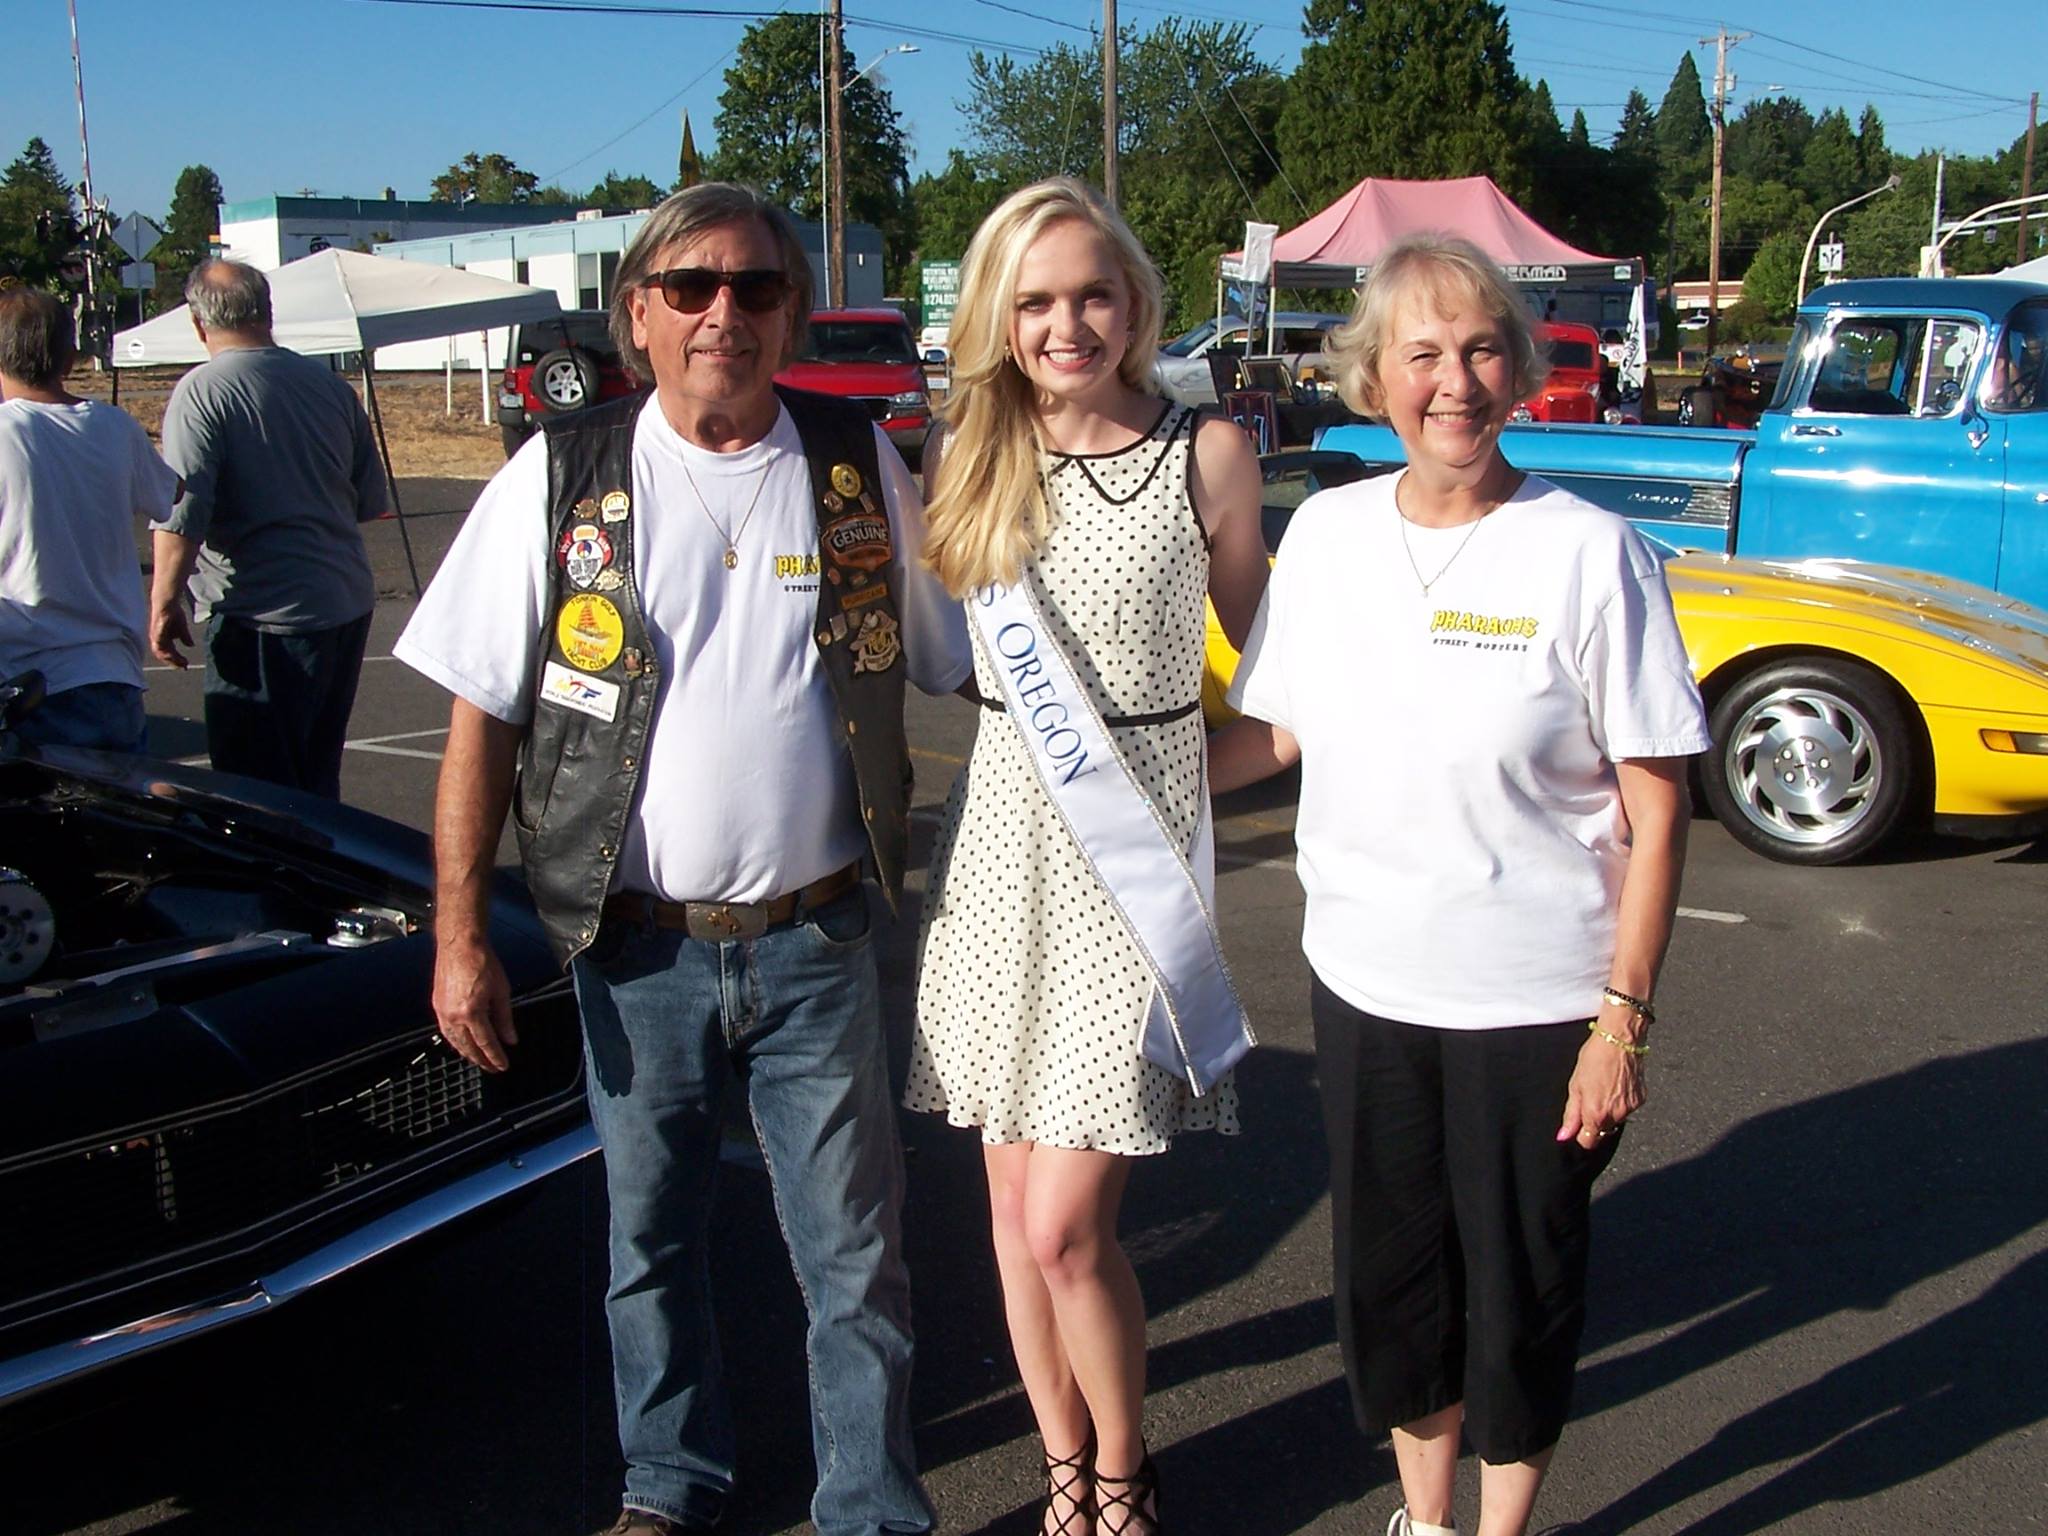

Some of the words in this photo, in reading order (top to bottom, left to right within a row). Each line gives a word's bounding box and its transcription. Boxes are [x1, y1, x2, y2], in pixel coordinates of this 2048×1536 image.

[833, 526, 888, 548] GENUINE
[571, 596, 597, 606] TONKIN
[600, 600, 616, 616] GULF
[1433, 638, 1469, 647] STREET
[566, 648, 586, 666] YACHT
[588, 658, 608, 669] CLUB
[996, 622, 1099, 786] OREGON
